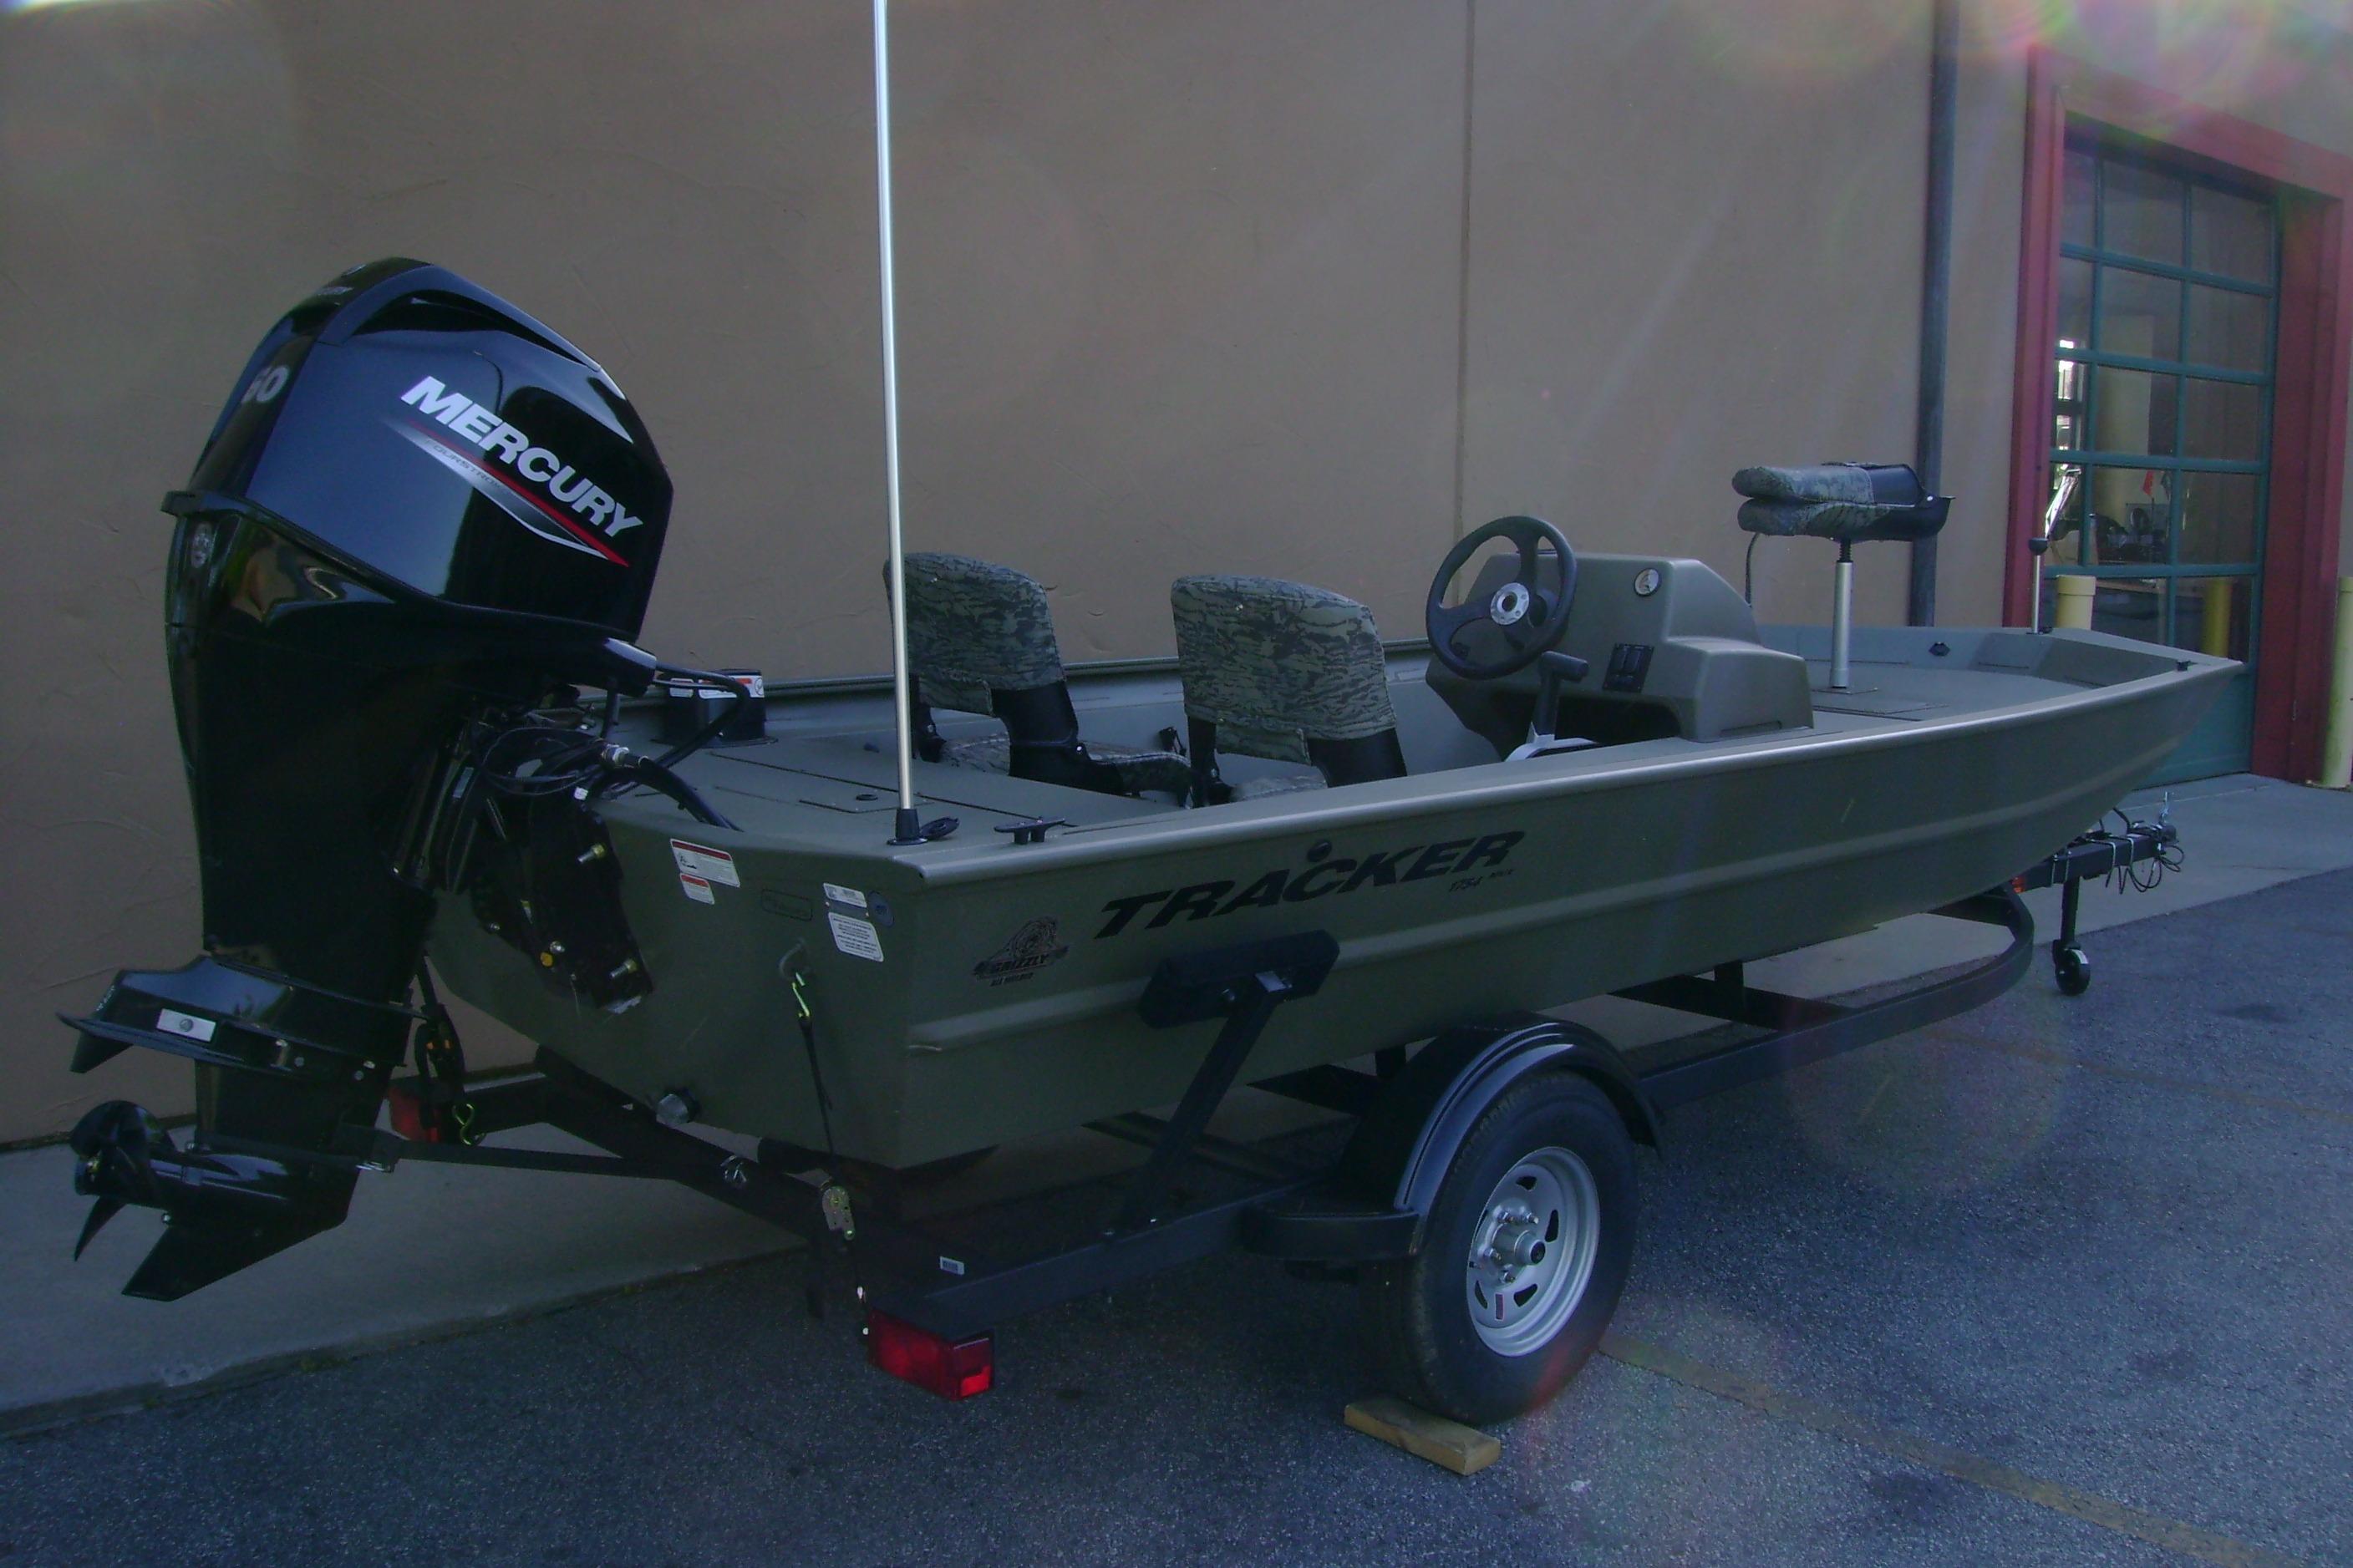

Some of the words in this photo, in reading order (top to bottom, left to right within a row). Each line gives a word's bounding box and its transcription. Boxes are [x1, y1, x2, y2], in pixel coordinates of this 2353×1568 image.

[401, 376, 643, 537] MERCURY
[424, 439, 506, 494] FOURSTRO
[1094, 831, 1526, 939] TRACKER
